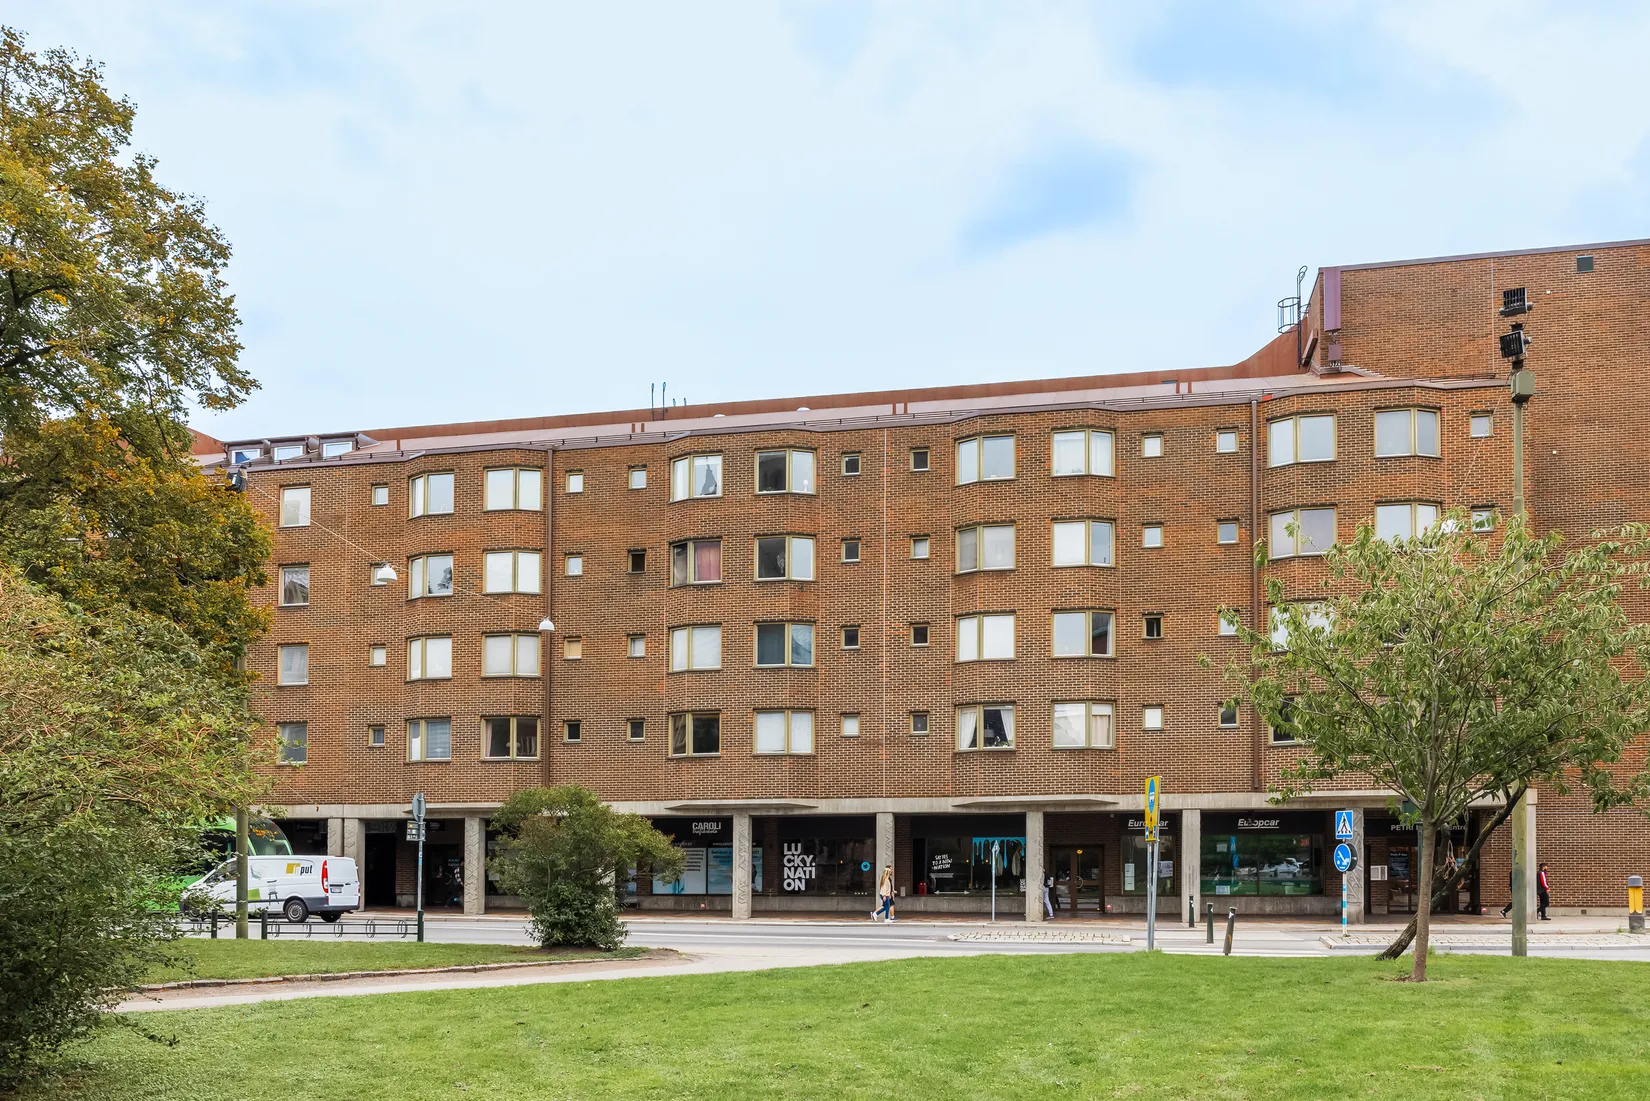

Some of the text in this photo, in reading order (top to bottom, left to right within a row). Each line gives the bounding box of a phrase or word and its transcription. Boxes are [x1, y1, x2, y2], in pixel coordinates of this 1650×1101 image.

[1128, 819, 1169, 827] Eurar
[783, 843, 802, 855] LU
[783, 855, 816, 867] CKY.
[783, 867, 816, 879] NATI
[783, 878, 806, 891] ON
